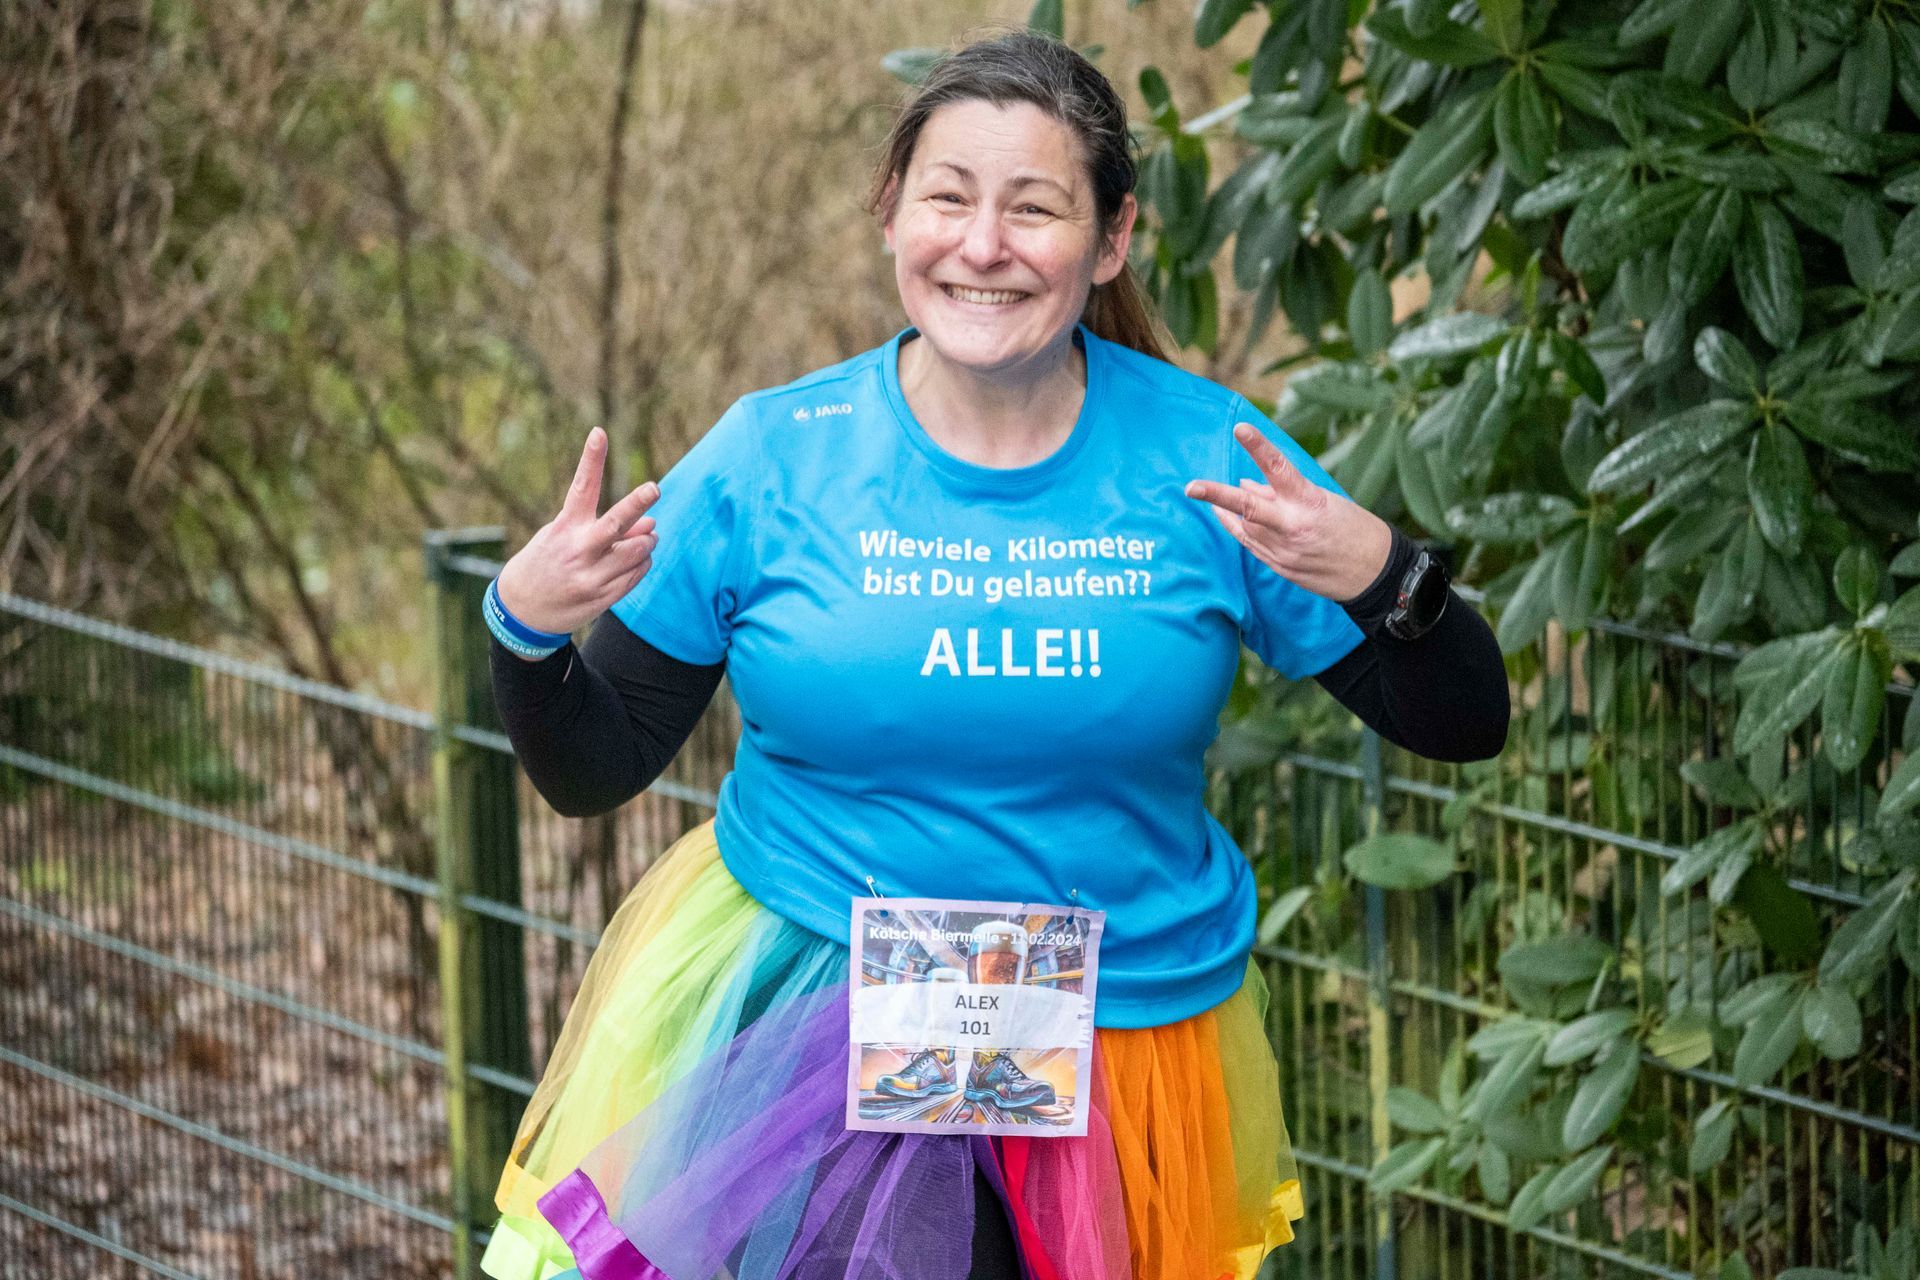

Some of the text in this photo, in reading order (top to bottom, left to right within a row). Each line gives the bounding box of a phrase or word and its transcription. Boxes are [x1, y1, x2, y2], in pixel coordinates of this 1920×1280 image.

[815, 403, 853, 418] JAKO
[859, 530, 1155, 562] Wieviele Kilometer
[863, 566, 1151, 604] bist Du gelaufen??
[919, 627, 1102, 678] ALLE!!
[869, 926, 928, 940] Kölsche
[930, 928, 1000, 944] Biermeile
[955, 994, 999, 1010] ALEX
[960, 1020, 991, 1035] 101
